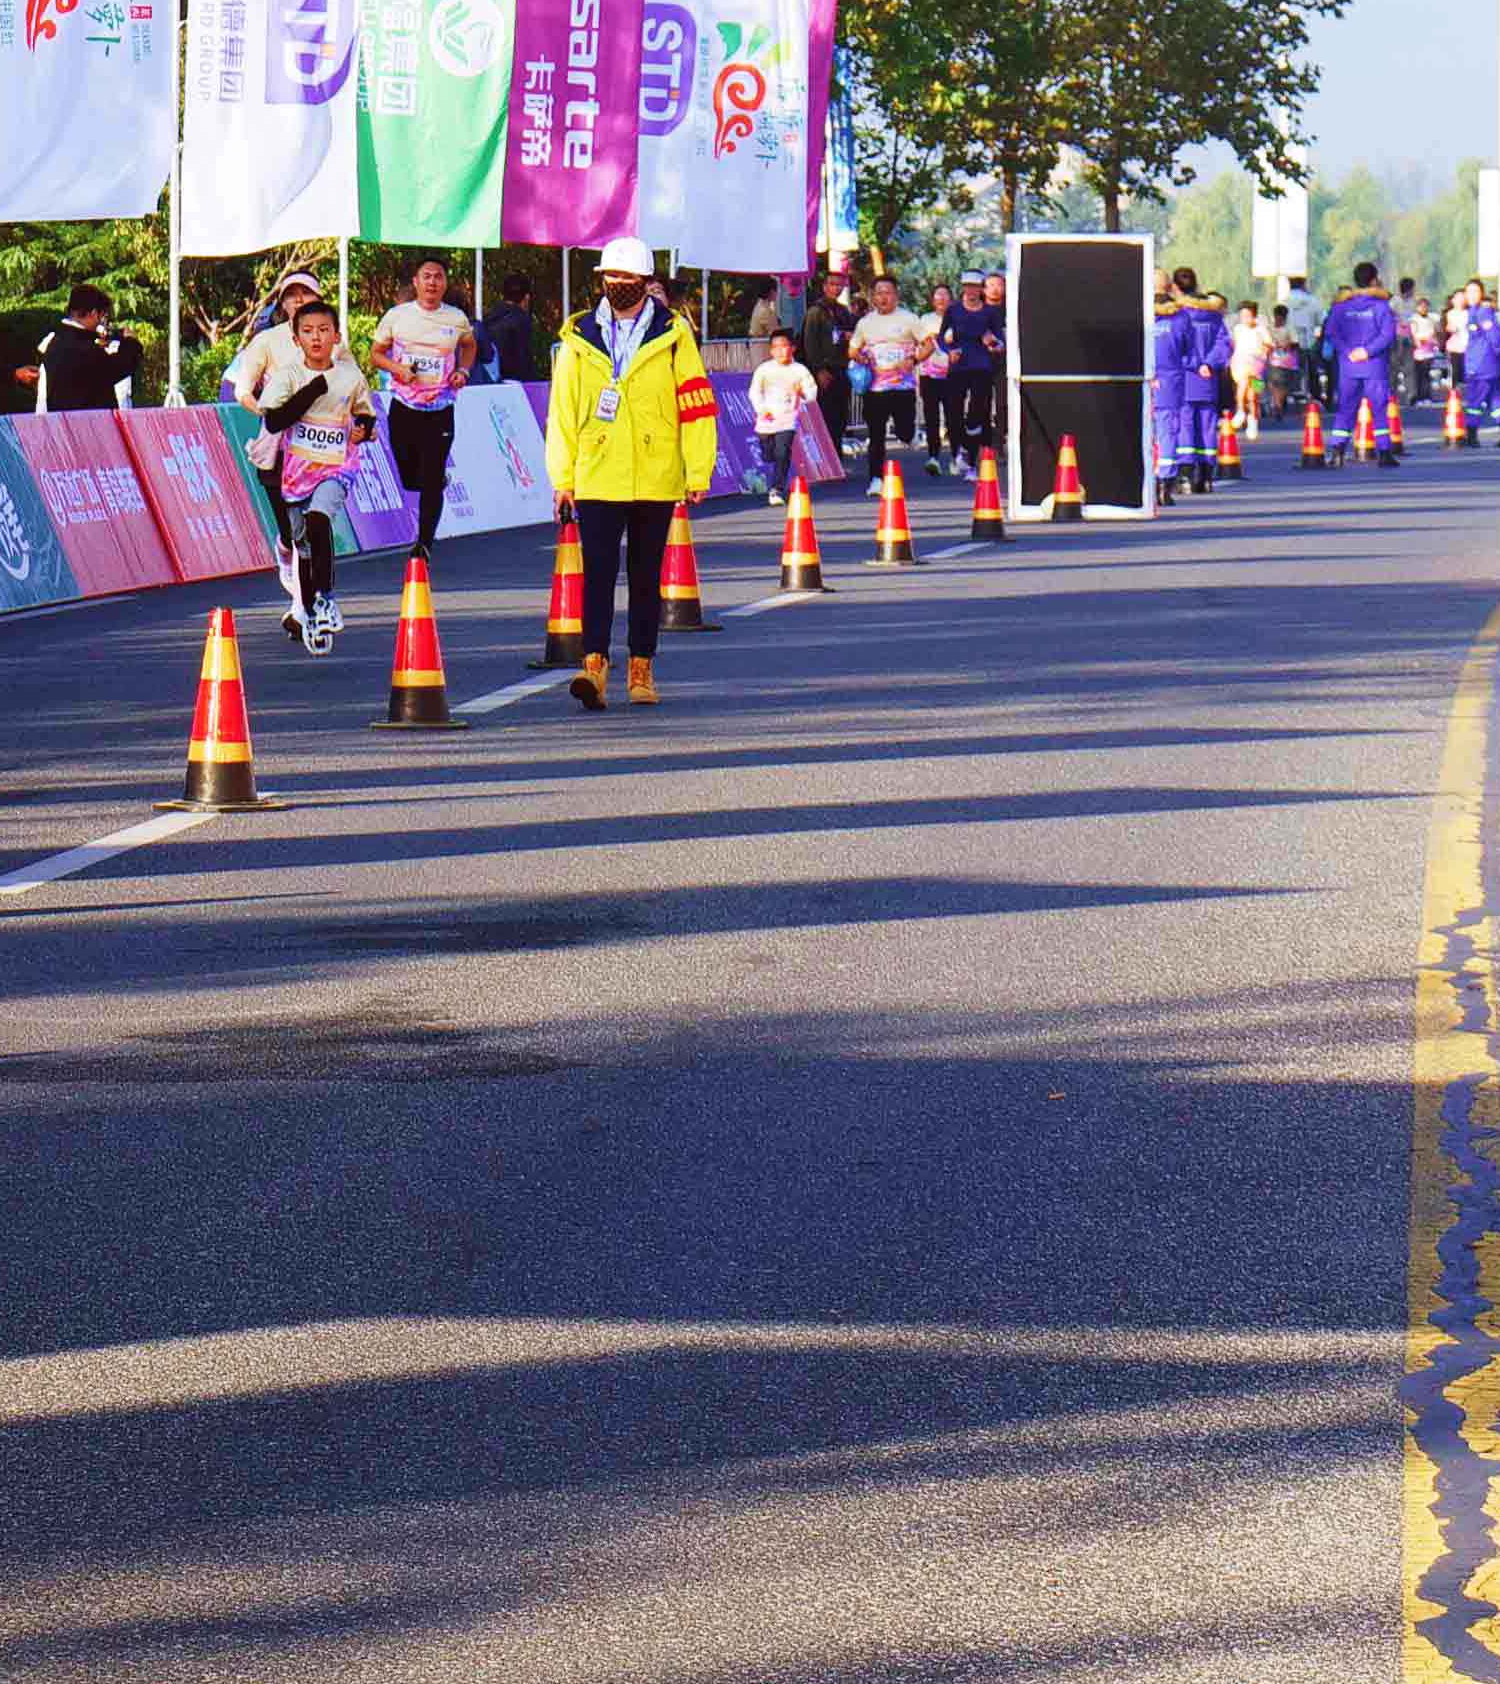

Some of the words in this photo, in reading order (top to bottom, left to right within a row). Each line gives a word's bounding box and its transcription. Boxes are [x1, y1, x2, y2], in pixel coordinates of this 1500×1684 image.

[521, 53, 556, 167] 卡萨帝
[297, 425, 345, 445] 30060
